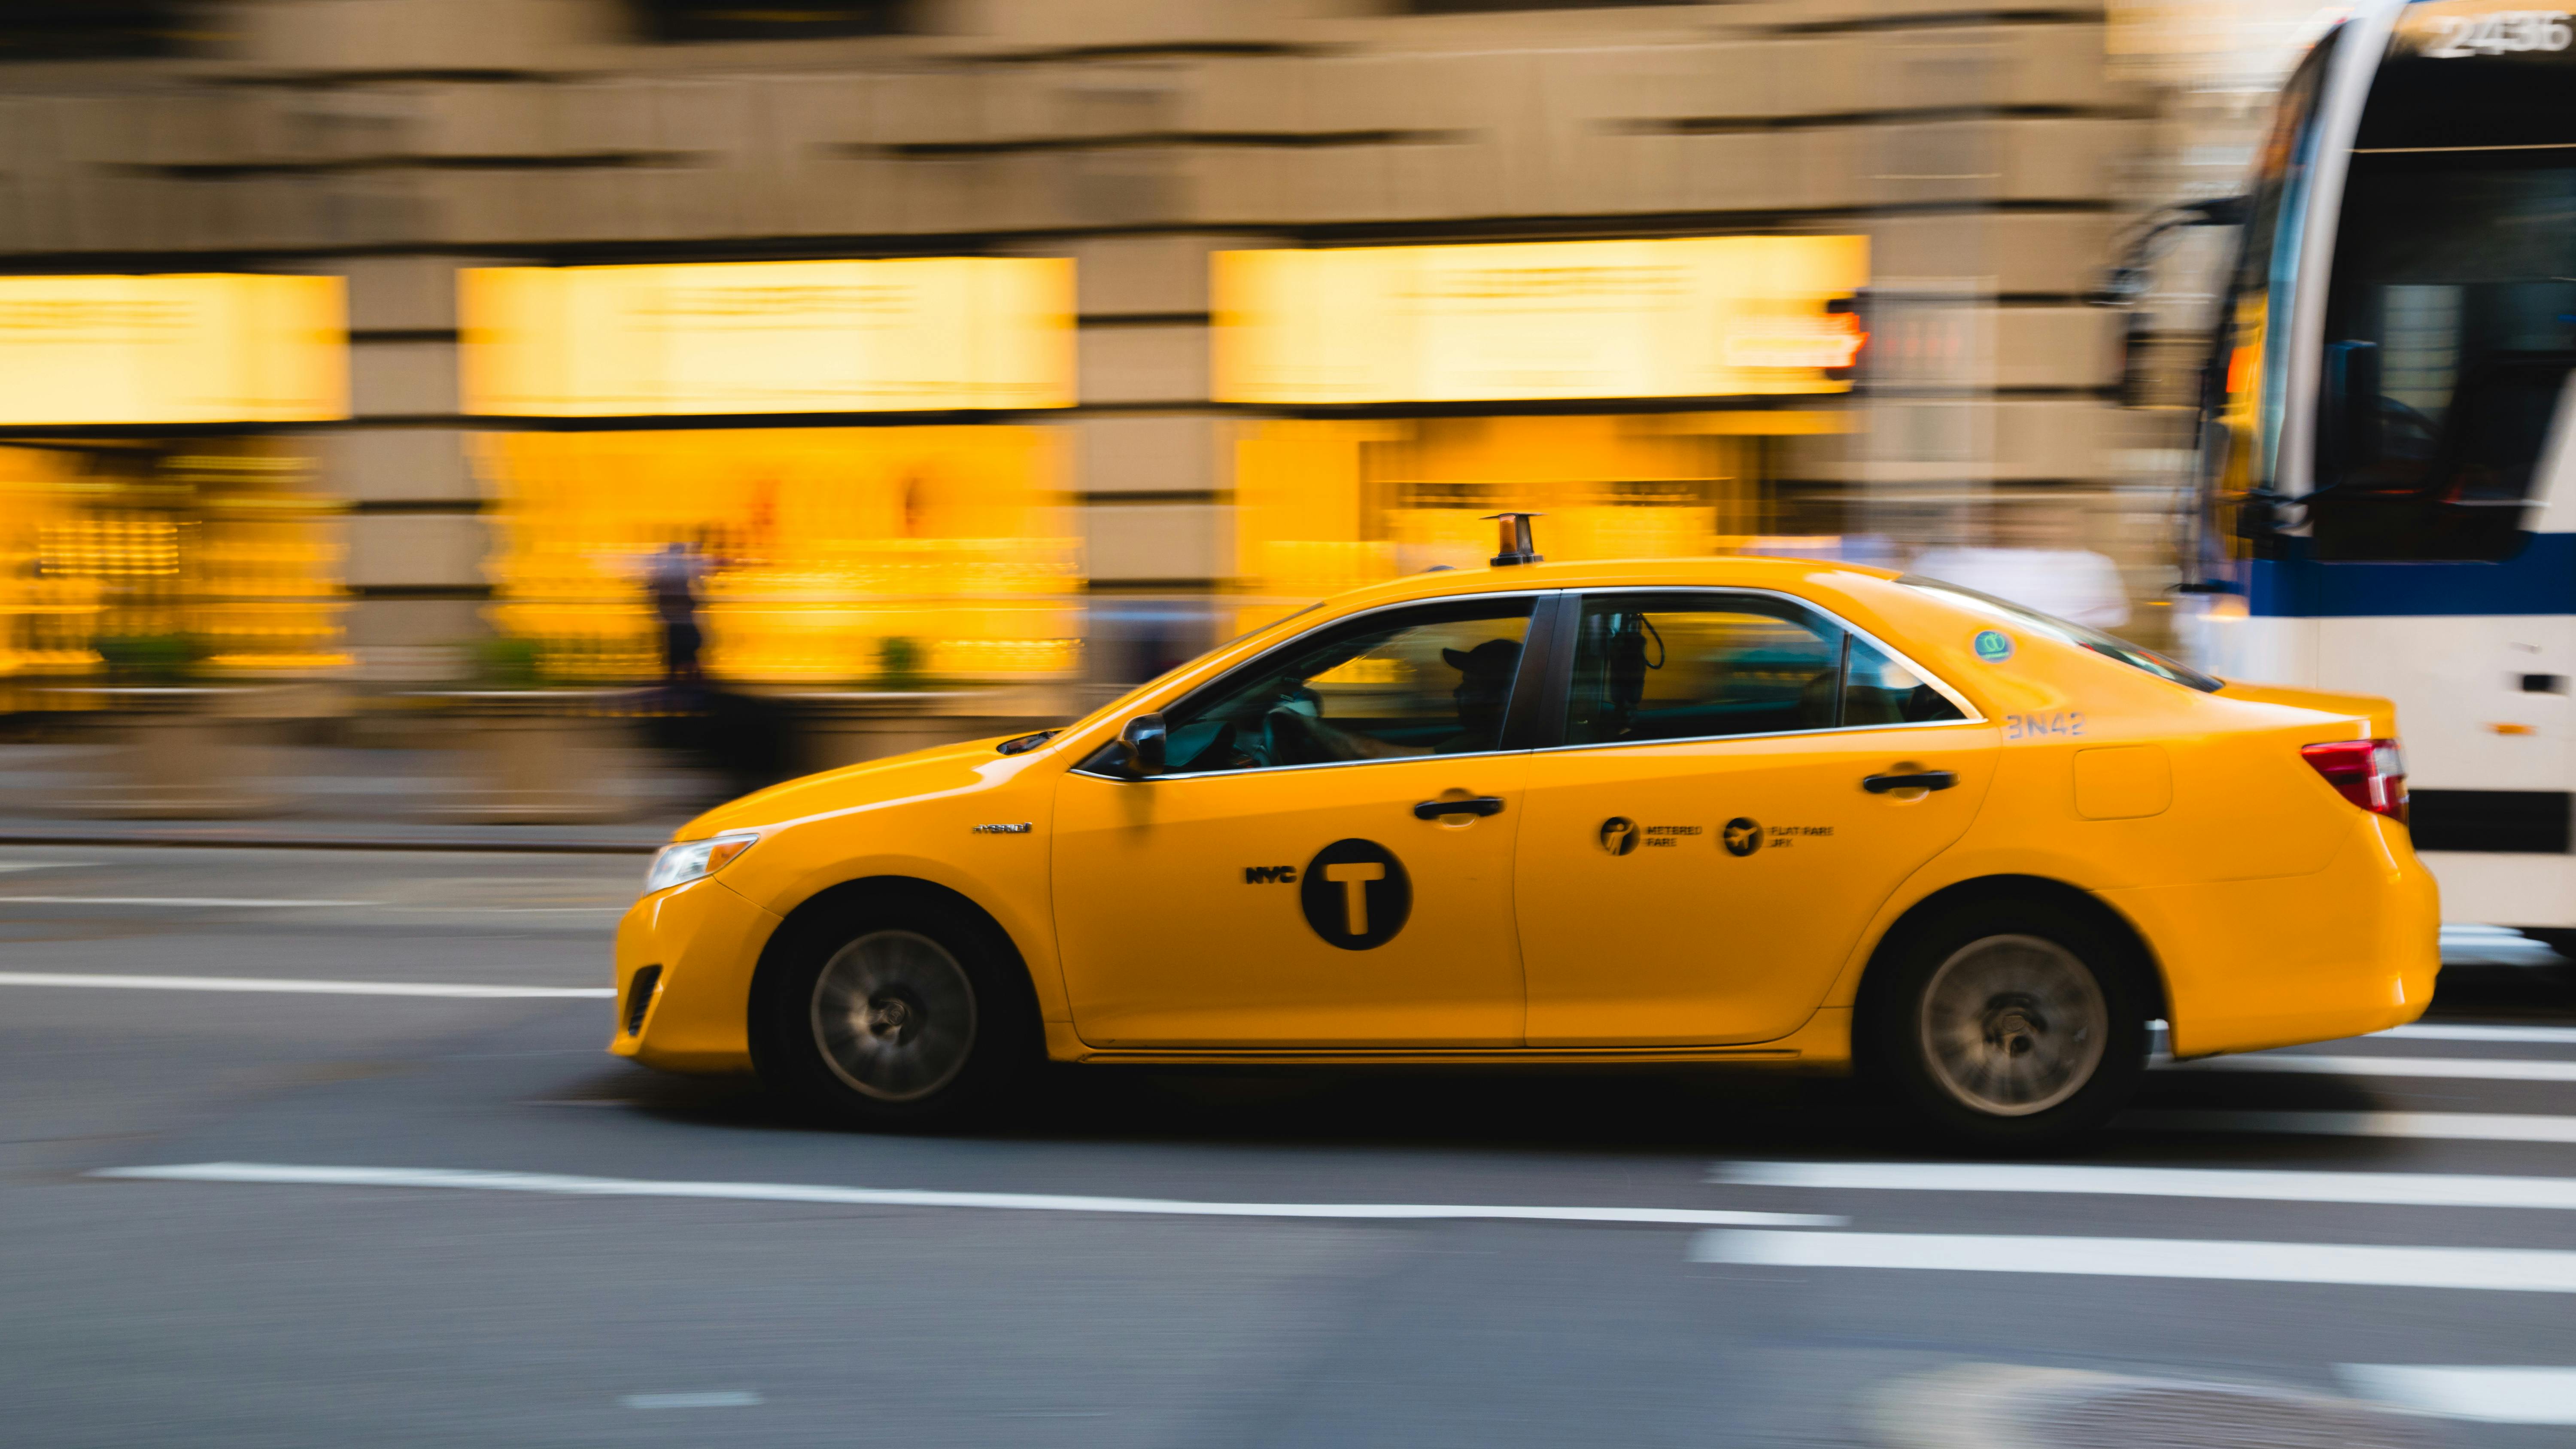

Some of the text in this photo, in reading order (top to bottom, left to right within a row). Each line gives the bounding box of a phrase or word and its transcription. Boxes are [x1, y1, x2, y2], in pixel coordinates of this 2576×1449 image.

[2008, 712, 2087, 739] 3N42
[1646, 826, 1703, 835] METERED
[1771, 826, 1834, 836] FLAT FARE
[1647, 838, 1677, 847] FARE
[1771, 838, 1793, 848] JFK
[1245, 863, 1385, 935] NYC T
